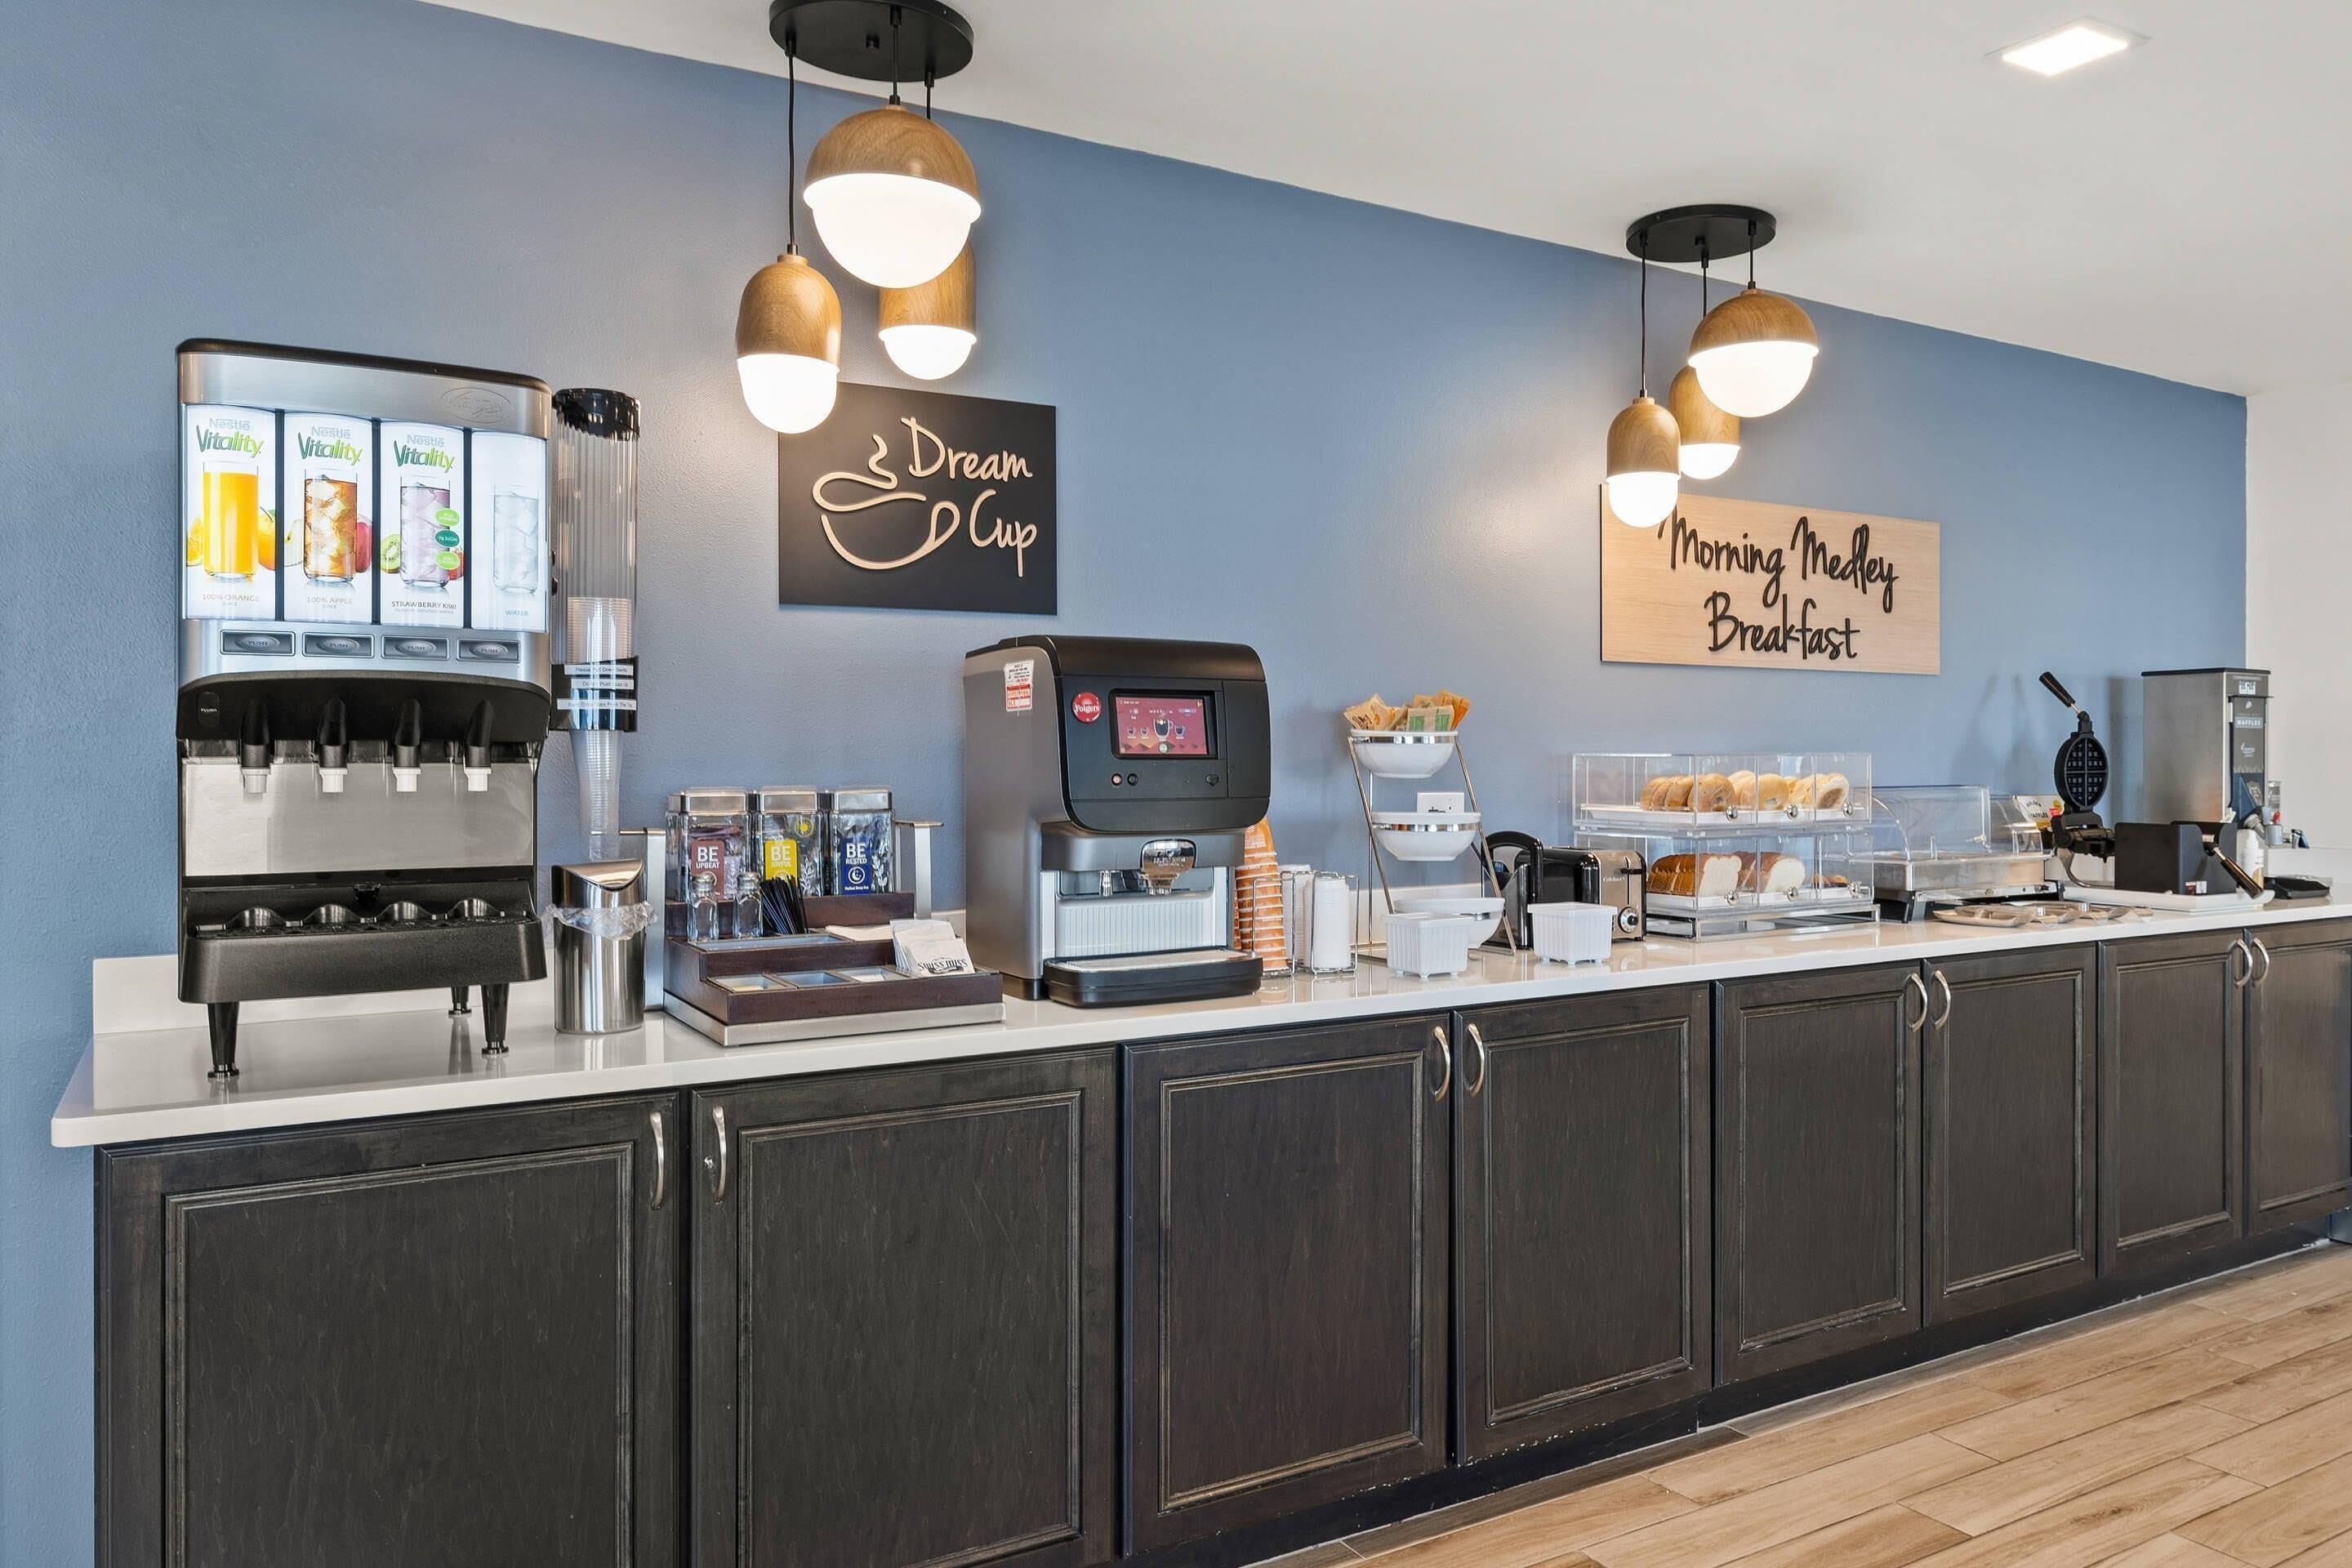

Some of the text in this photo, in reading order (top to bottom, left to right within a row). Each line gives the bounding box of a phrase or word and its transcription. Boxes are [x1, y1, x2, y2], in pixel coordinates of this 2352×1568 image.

[196, 424, 265, 459] Vitality
[297, 431, 363, 466] Vitality
[901, 416, 1033, 483] Dream
[393, 440, 456, 474] Vitality
[969, 488, 1038, 577] Cup
[1657, 504, 1900, 613] Morning Medley
[225, 594, 261, 603] ORANGE
[328, 597, 353, 605] APPLE
[391, 600, 441, 609] STRAWBERRY
[505, 608, 529, 617] WATER
[1704, 590, 1861, 660] Breakfast
[1075, 705, 1100, 714] Folgers
[697, 846, 719, 862] BE
[770, 845, 791, 862] BE
[845, 842, 866, 858] BE
[696, 861, 720, 870] UPBEAT
[770, 860, 792, 868] JOYFUL
